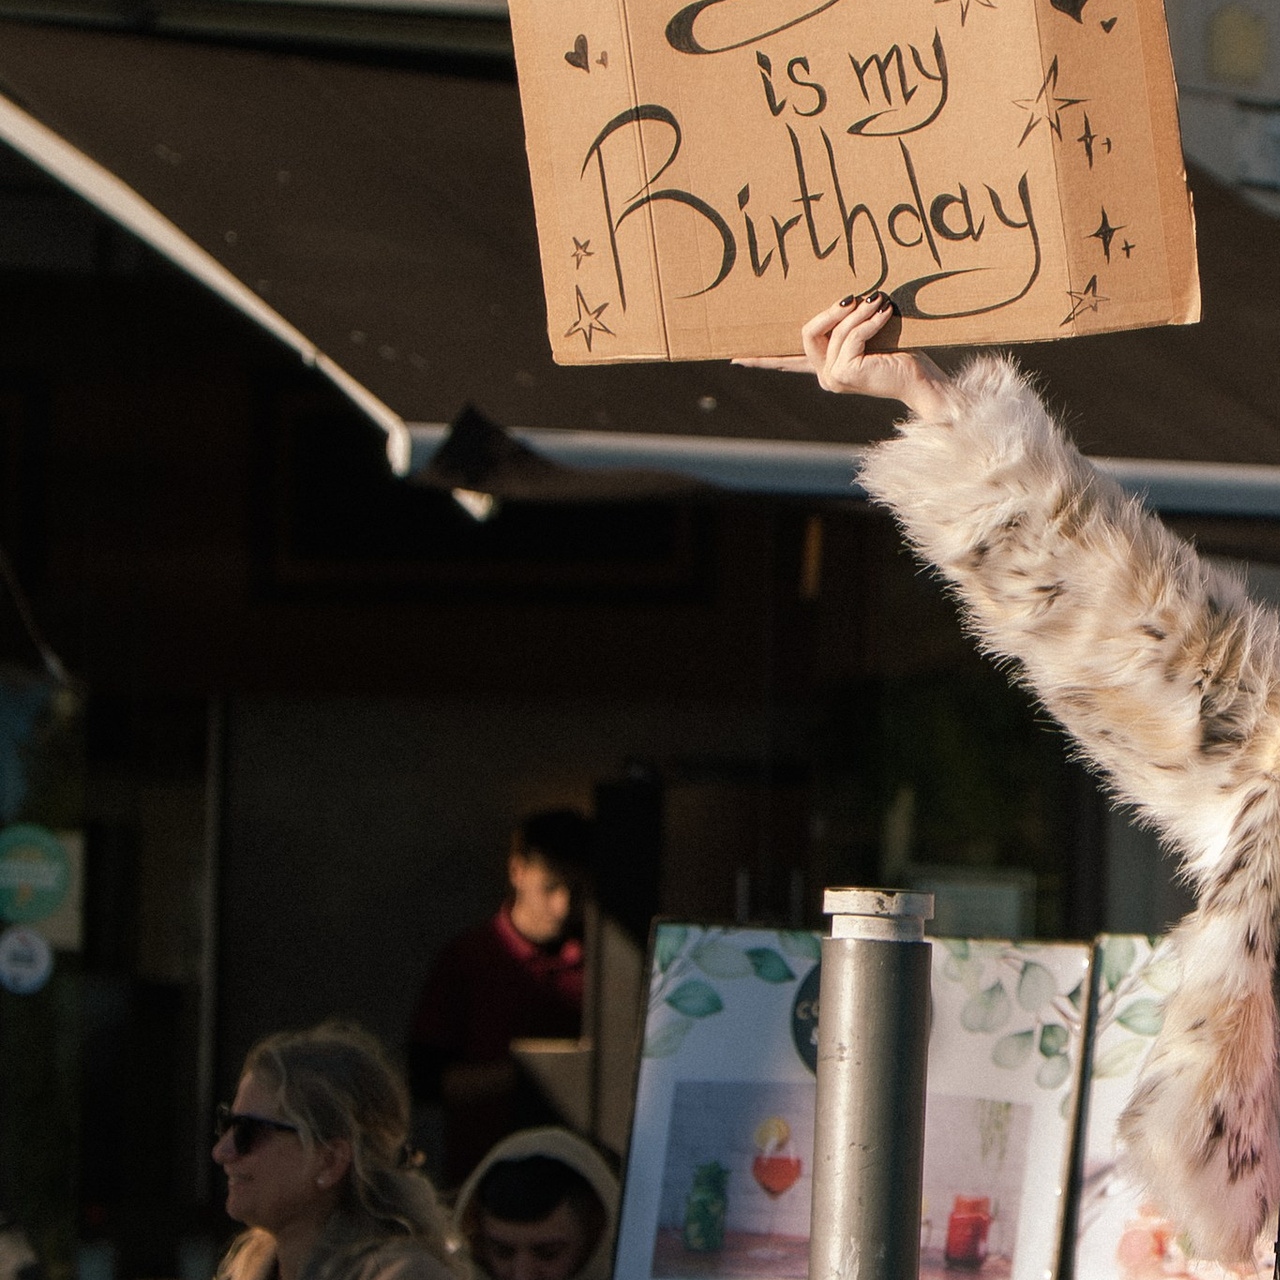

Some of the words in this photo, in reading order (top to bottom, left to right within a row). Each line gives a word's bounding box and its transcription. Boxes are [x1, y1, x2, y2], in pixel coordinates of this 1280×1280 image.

[755, 49, 828, 117] is
[846, 26, 949, 137] my
[579, 103, 1042, 320] Birthday
